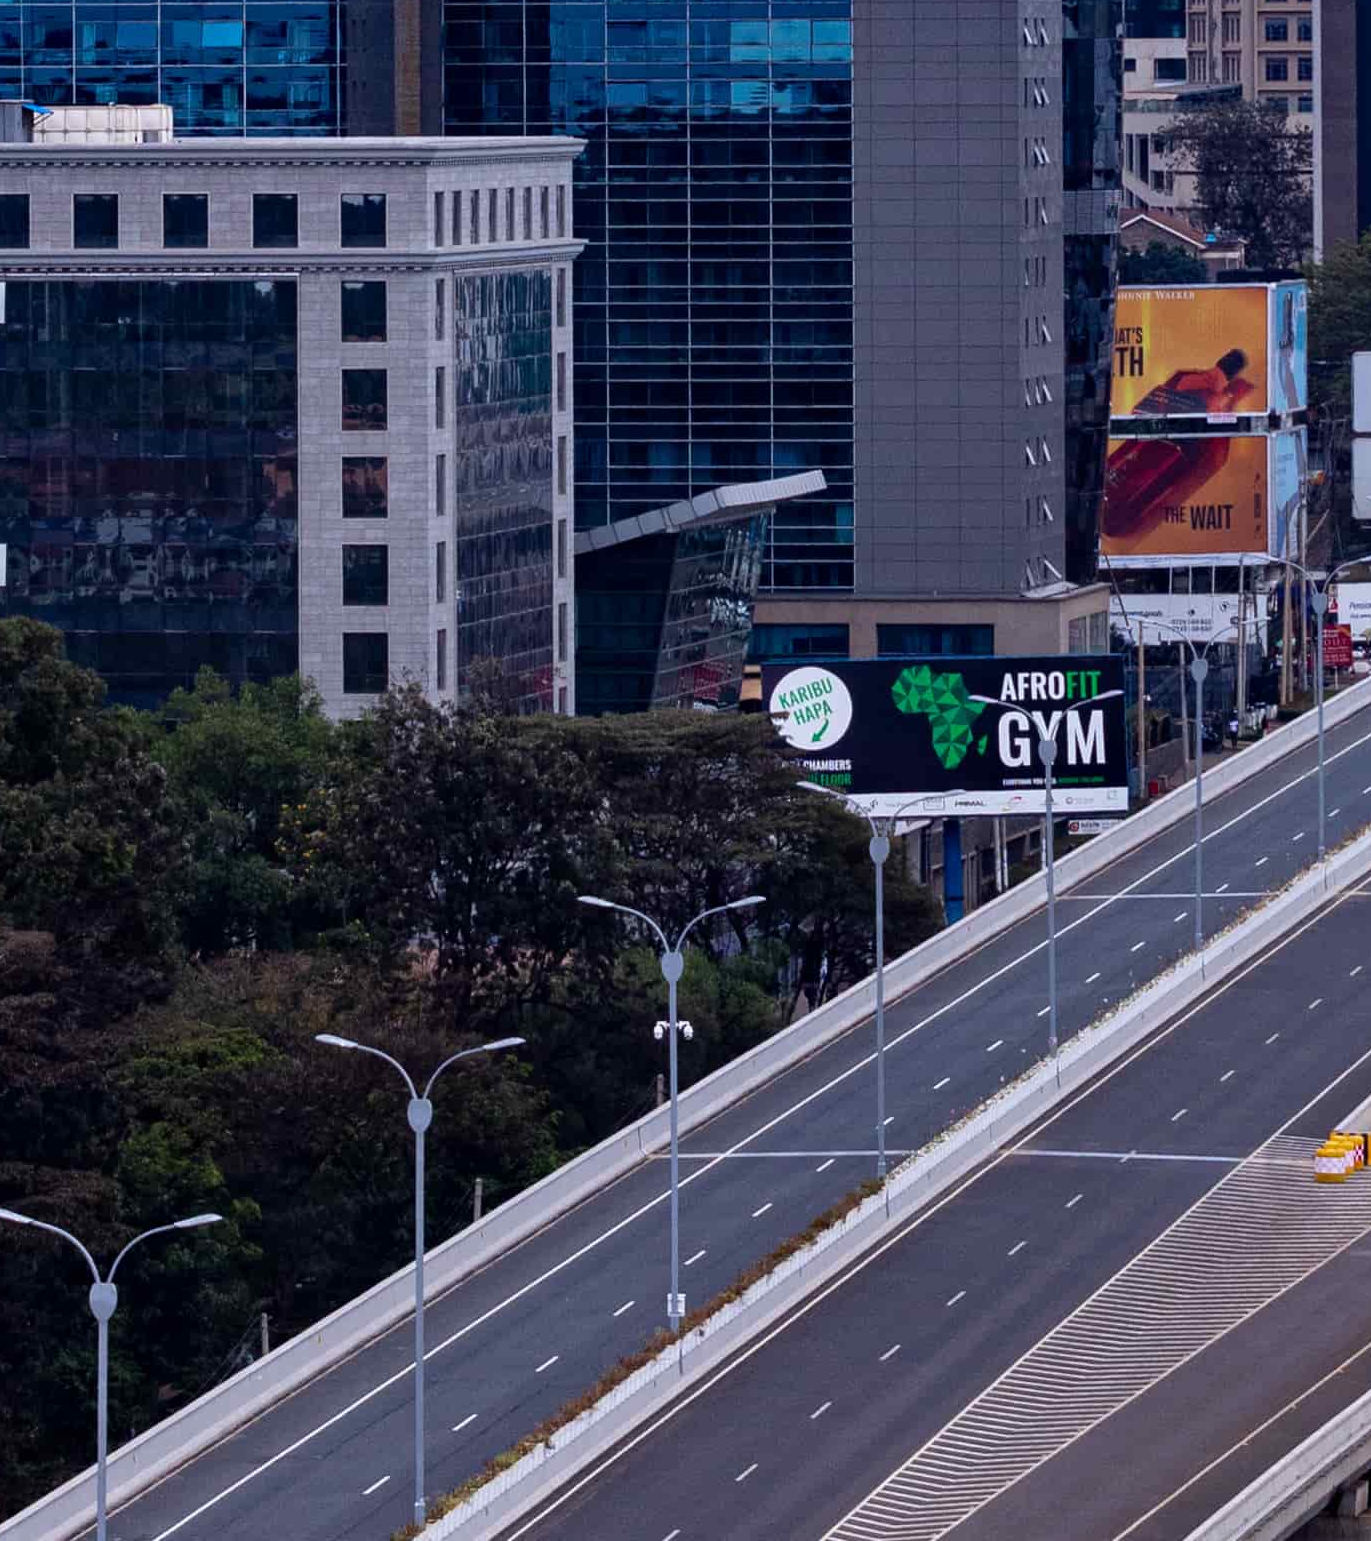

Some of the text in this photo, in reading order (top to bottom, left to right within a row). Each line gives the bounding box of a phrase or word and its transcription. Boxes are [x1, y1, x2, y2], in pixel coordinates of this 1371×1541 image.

[1114, 346, 1144, 377] TH
[1162, 506, 1186, 524] THE
[1189, 504, 1234, 531] WAIT
[778, 677, 833, 710] KARIBU
[1000, 670, 1102, 702] AFROFIT
[793, 700, 833, 726] HAPA
[998, 709, 1106, 767] GYM
[803, 759, 852, 771] CHAMBERS
